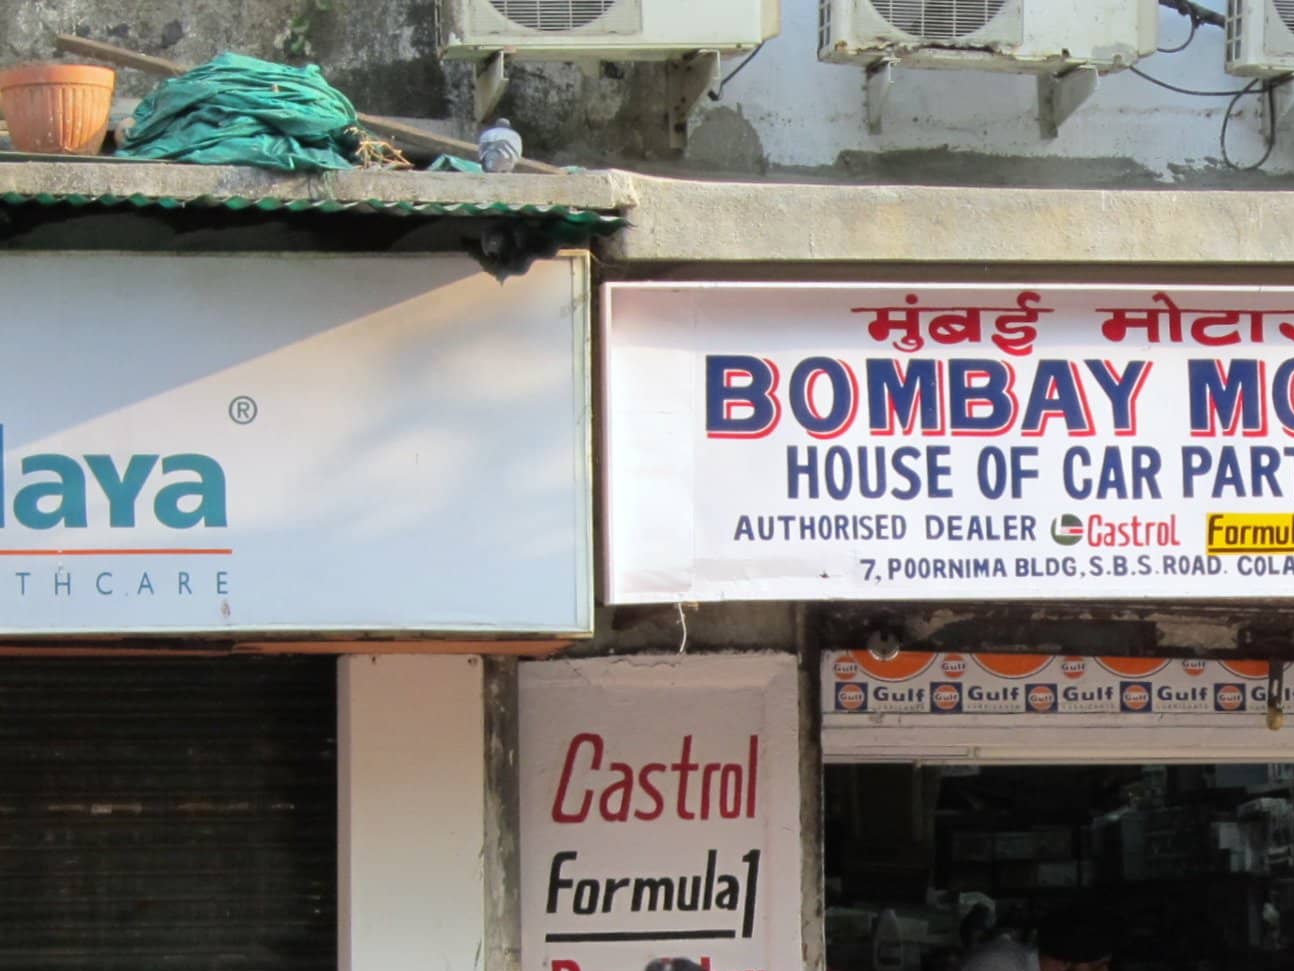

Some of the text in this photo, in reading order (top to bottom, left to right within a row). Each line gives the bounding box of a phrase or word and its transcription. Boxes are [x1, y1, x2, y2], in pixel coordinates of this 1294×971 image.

[851, 291, 1055, 356] मुंबई
[705, 354, 1153, 439] BOMBAY
[0, 424, 228, 530] aya
[785, 444, 954, 500] HOUSE
[976, 445, 1040, 500] OF
[1061, 445, 1163, 500] CAR
[733, 514, 908, 541] AUTHORISED
[924, 514, 1038, 541] DEALER
[1086, 513, 1181, 547] Castrol
[888, 558, 1008, 580] POORNIMA
[873, 686, 925, 702] Gulf
[967, 685, 1020, 701] Gulf
[1062, 686, 1114, 701] Gulf
[1157, 685, 1209, 701] Gulf
[552, 732, 759, 824] Castrol
